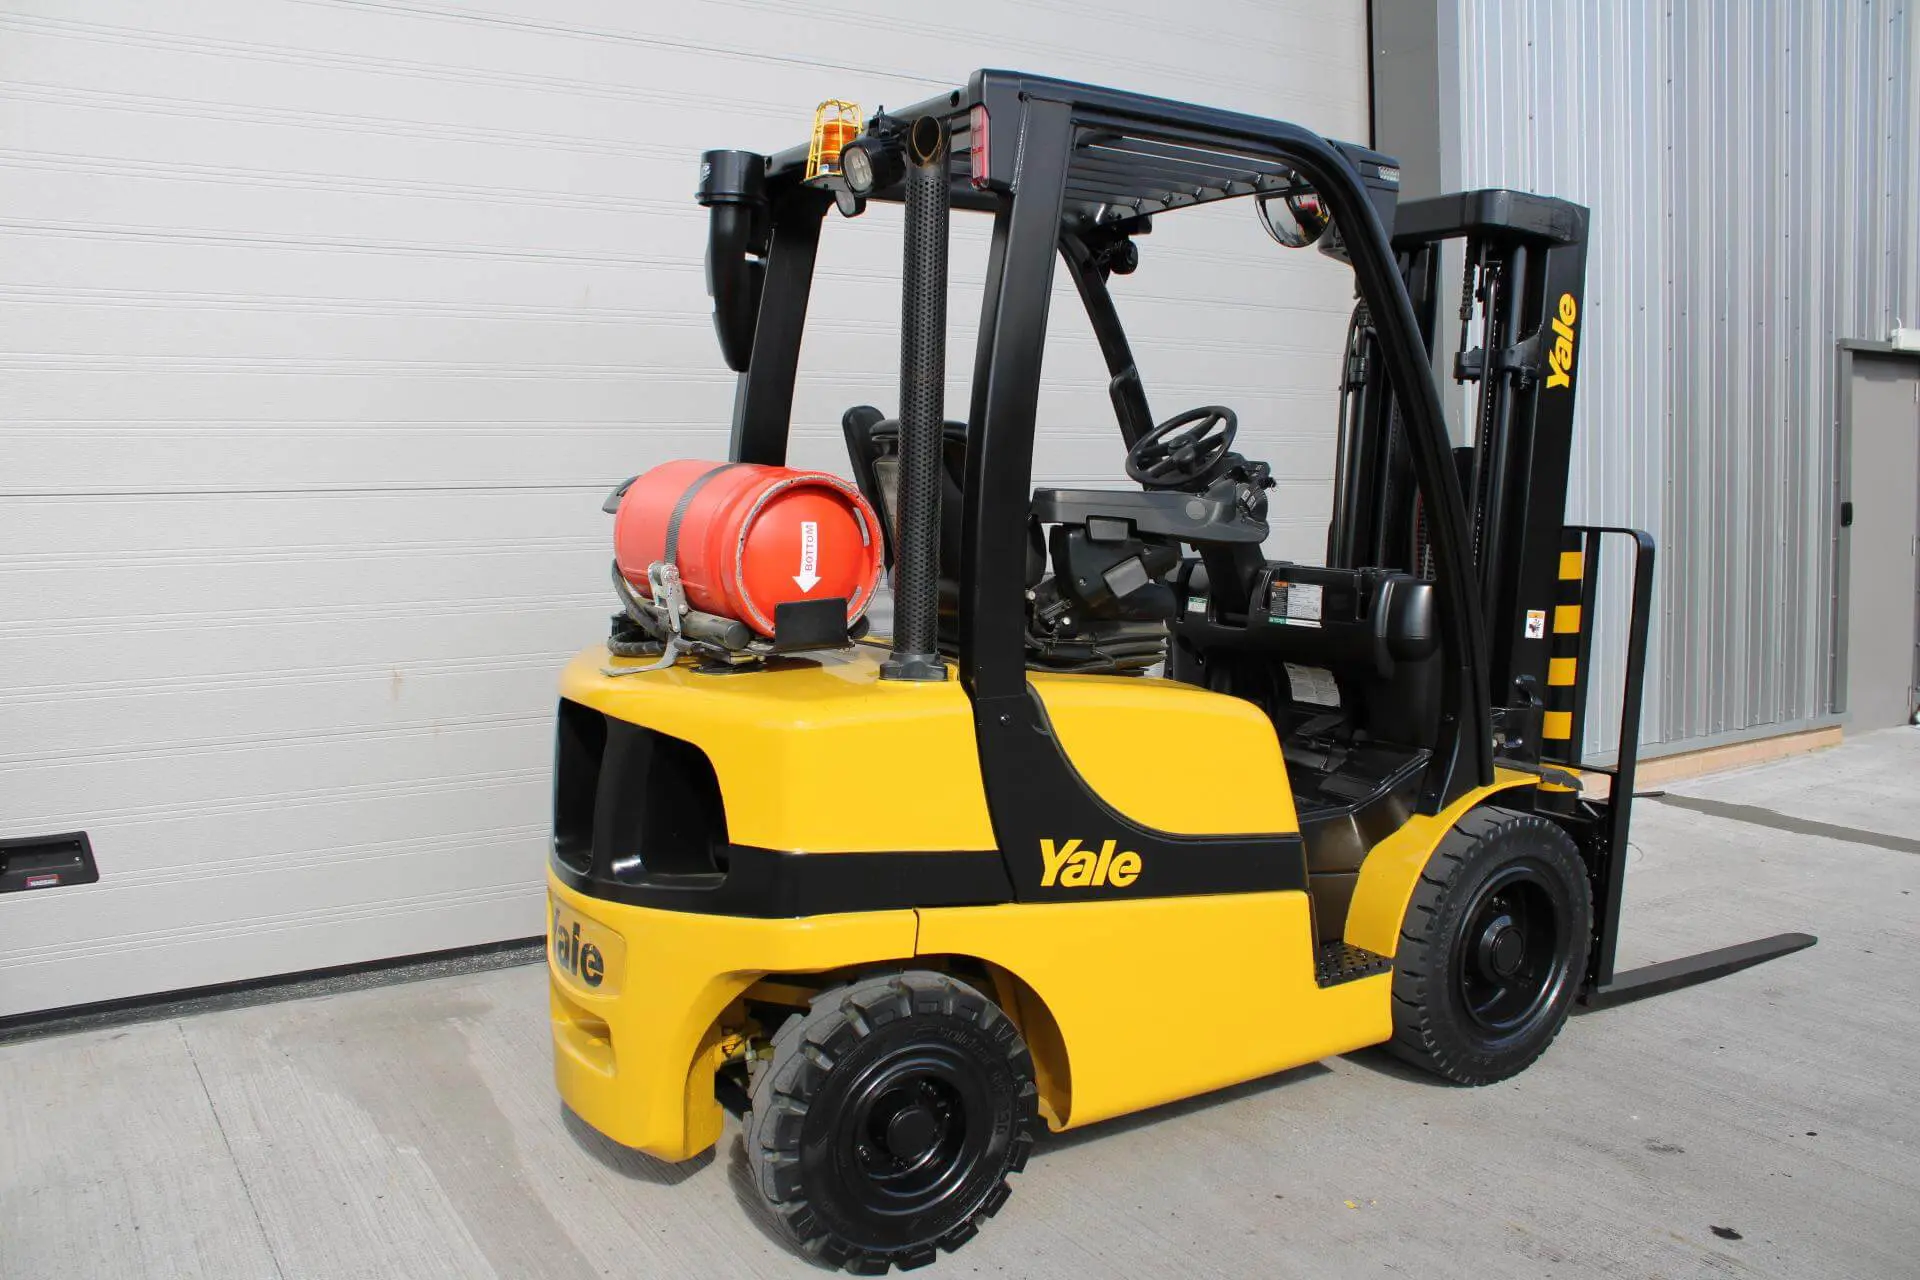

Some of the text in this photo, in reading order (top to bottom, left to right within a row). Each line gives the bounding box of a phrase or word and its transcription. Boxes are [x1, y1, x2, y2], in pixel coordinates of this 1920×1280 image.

[1545, 293, 1577, 389] Yale
[804, 524, 815, 572] BOTTOM
[1039, 838, 1142, 888] Yale
